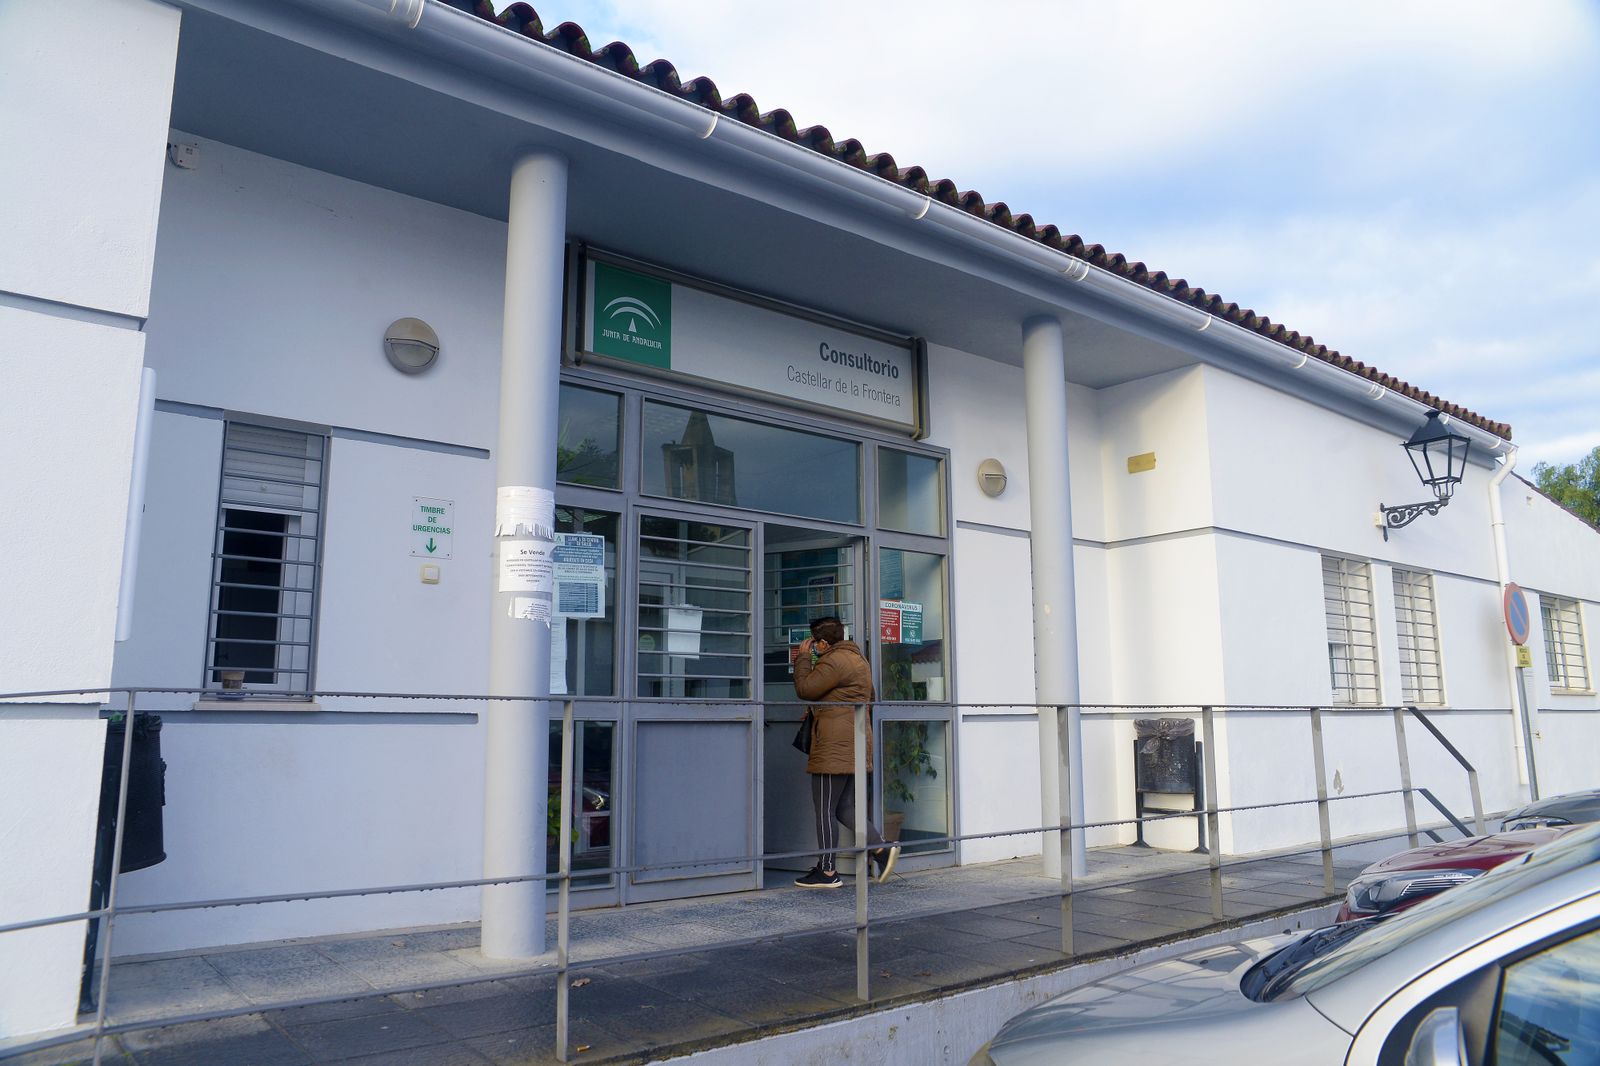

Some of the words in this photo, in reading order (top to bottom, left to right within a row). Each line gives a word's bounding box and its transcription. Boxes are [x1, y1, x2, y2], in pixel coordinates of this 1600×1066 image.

[602, 329, 620, 339] JUNTA
[623, 333, 630, 342] DE
[819, 342, 899, 379] Consultorio
[787, 365, 832, 390] Castellar
[835, 378, 848, 394] de
[850, 380, 859, 397] la
[862, 383, 901, 407] Frontera
[420, 506, 445, 514] TIMBRE
[412, 525, 450, 534] URGENCIAS
